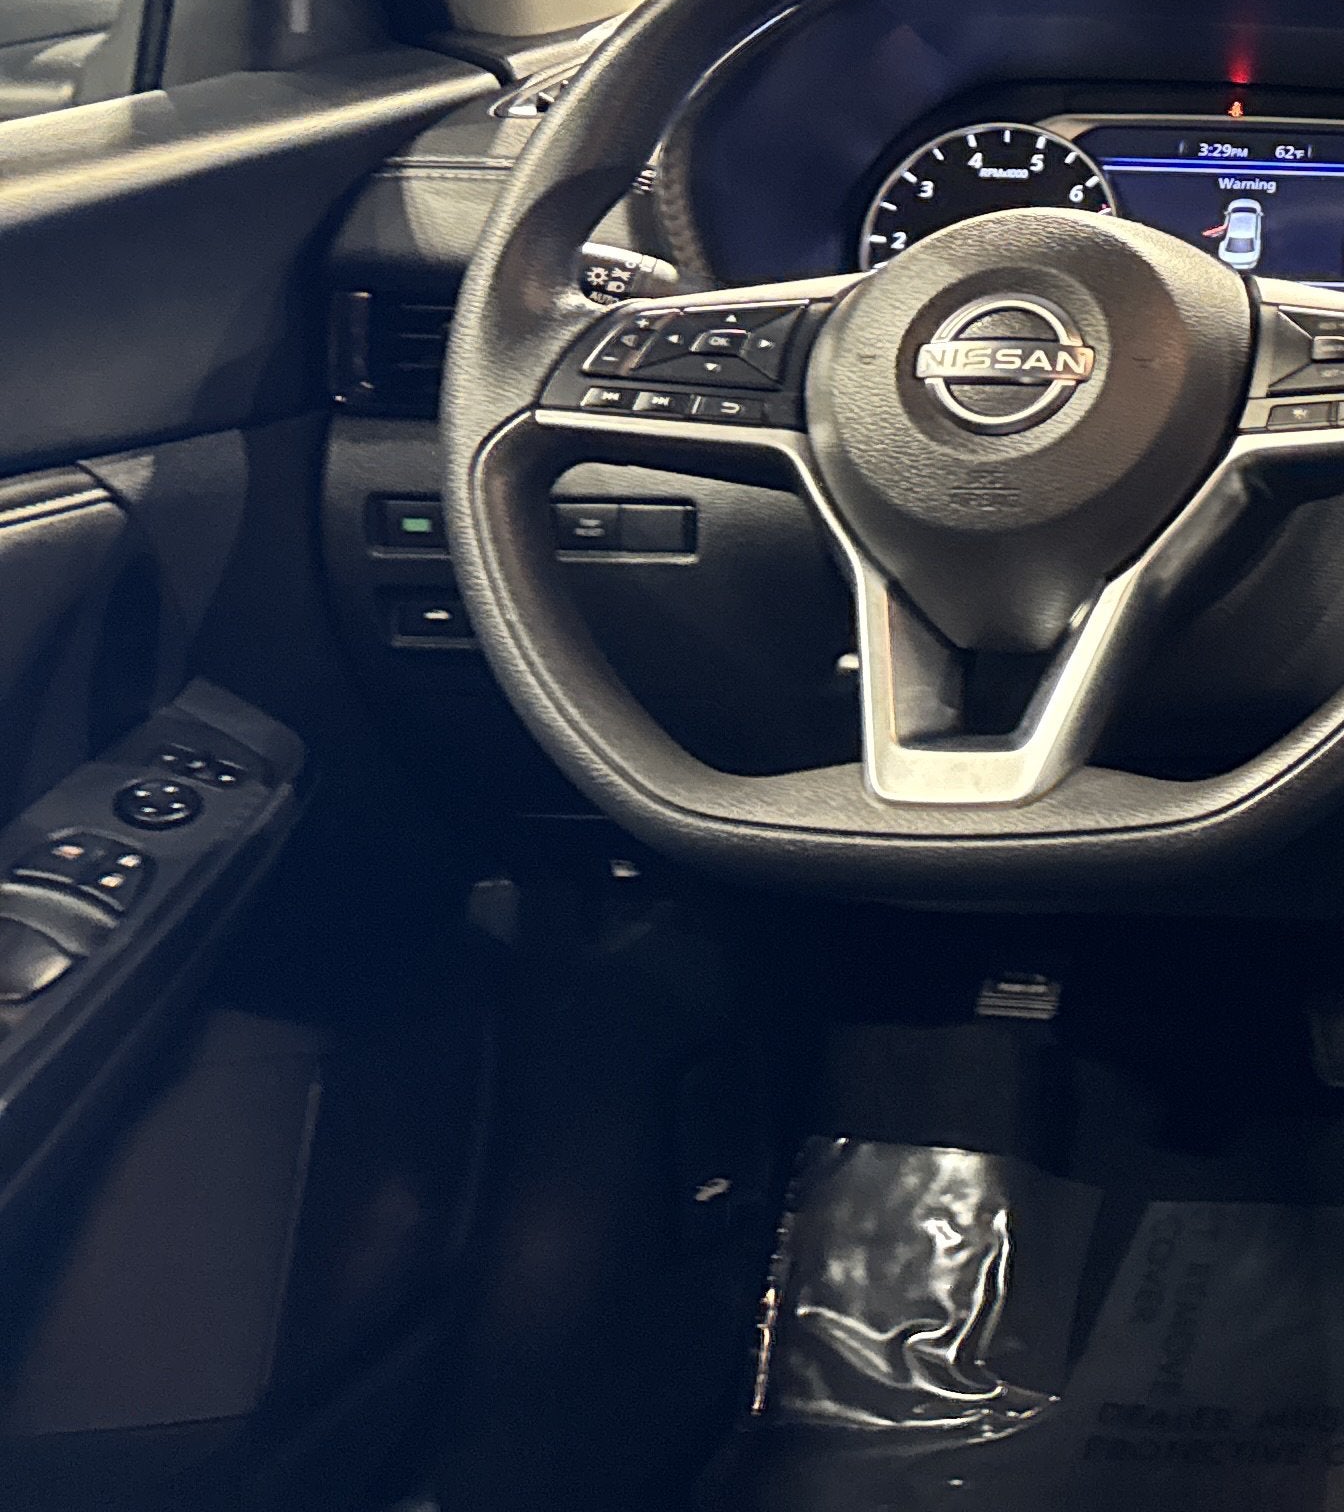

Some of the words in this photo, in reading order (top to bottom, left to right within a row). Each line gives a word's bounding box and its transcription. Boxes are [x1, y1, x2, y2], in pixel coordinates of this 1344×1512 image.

[967, 152, 983, 169] 4
[1029, 153, 1045, 173] 5
[917, 180, 935, 200] 3
[1069, 184, 1085, 203] 6
[1218, 177, 1277, 194] Warning
[890, 232, 907, 250] 2
[708, 336, 731, 347] OK
[922, 348, 1087, 375] NISSAN
